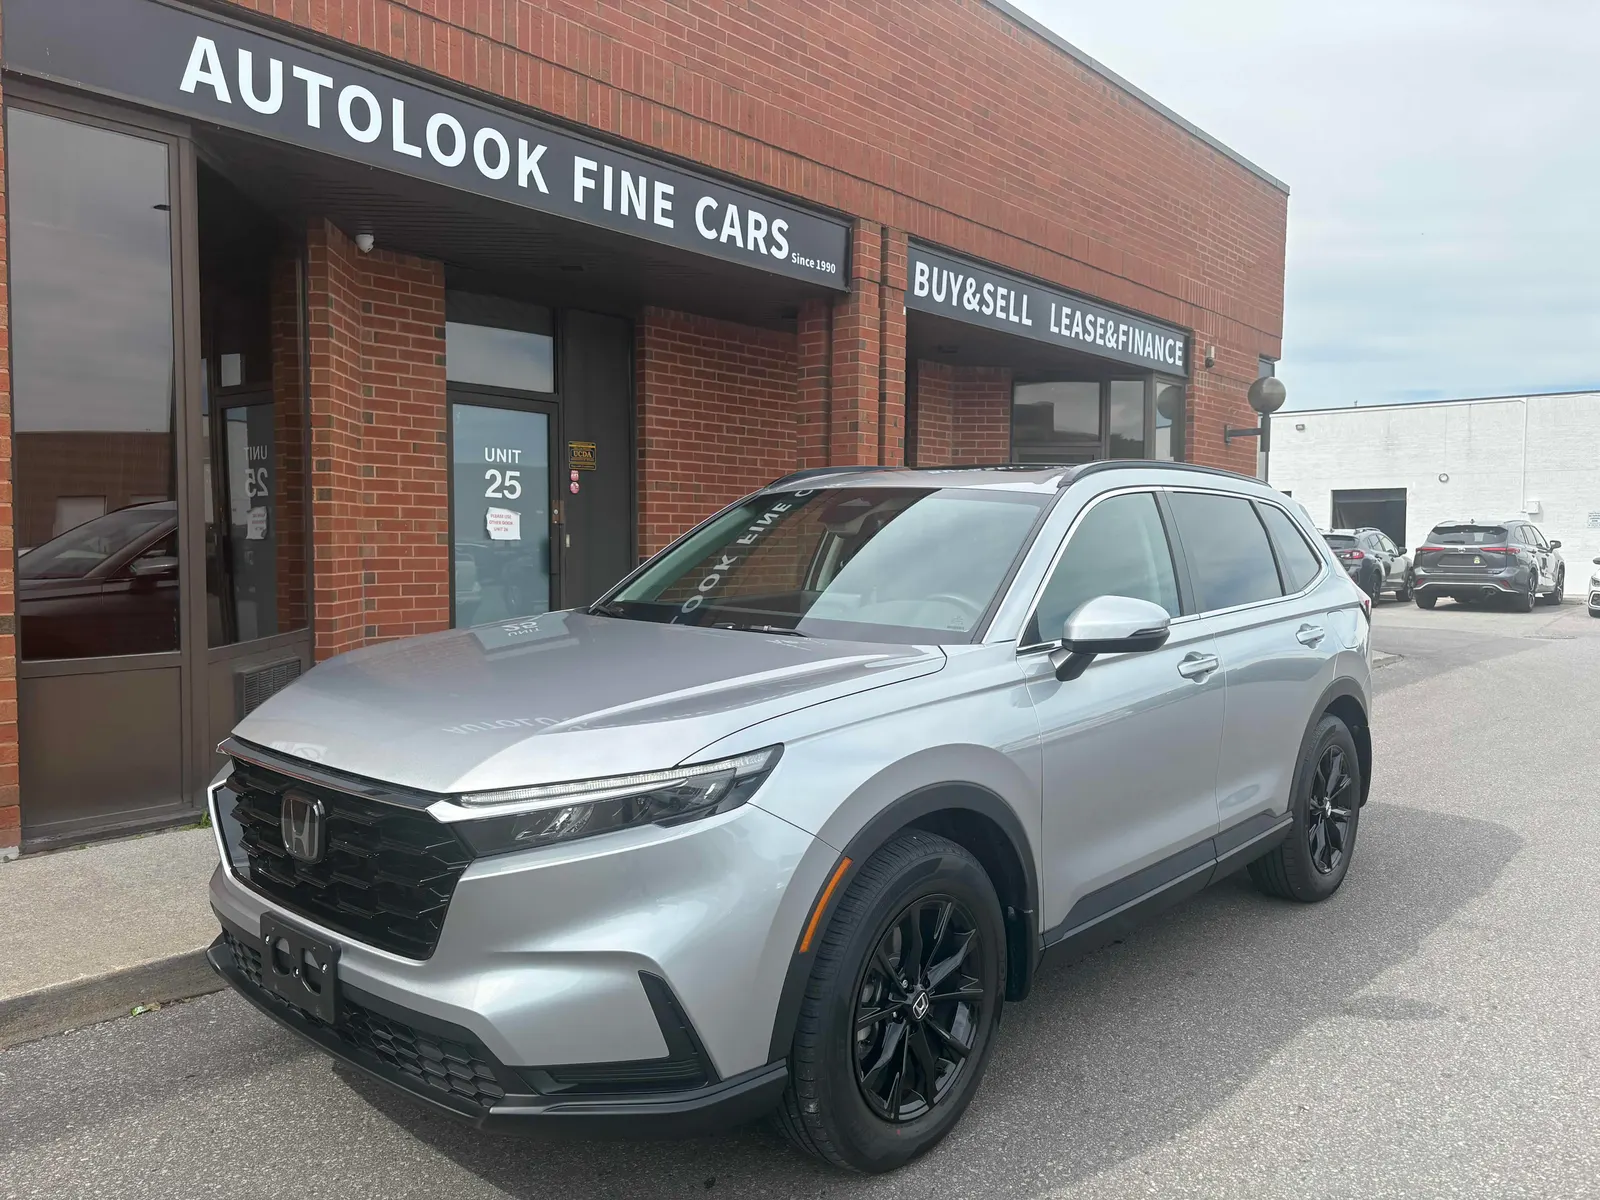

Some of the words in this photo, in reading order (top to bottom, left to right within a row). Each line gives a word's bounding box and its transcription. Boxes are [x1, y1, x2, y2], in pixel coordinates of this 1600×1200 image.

[179, 36, 550, 194] AUTOLOOK
[573, 155, 675, 228] FINE
[694, 196, 790, 260] CARS
[791, 252, 815, 269] Since
[816, 259, 836, 274] 1990
[913, 261, 1033, 326] BUY&SELL
[1049, 302, 1184, 366] LEASE&FINANCE
[484, 447, 522, 464] UNIT
[573, 450, 592, 458] UCDA
[484, 469, 522, 500] 25
